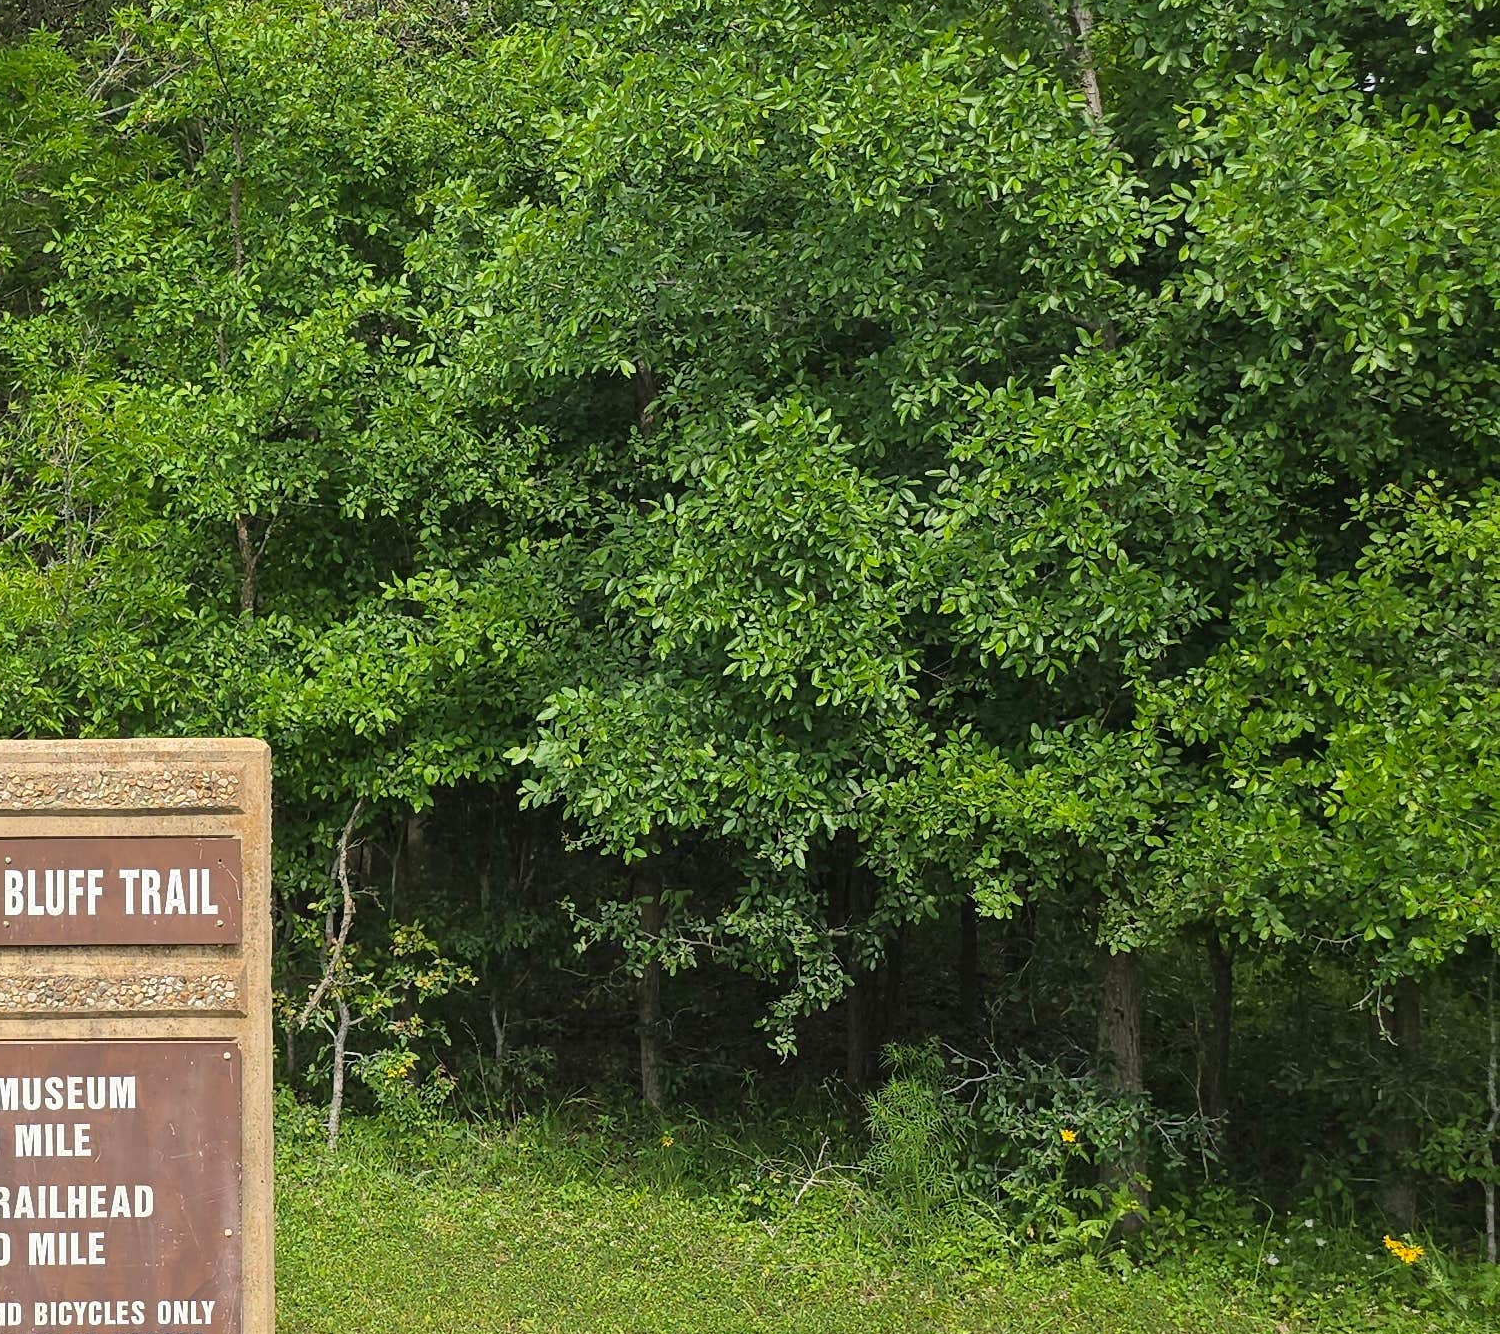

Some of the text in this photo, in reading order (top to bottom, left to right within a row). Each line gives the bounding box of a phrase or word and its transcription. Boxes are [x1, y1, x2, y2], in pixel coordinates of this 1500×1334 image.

[5, 869, 103, 916] BLUFF
[119, 869, 218, 914] TRAIL
[15, 1124, 91, 1157] MILE
[29, 1232, 105, 1265] MILE
[35, 1301, 145, 1325] BICYCLES
[158, 1301, 215, 1326] ONLY
